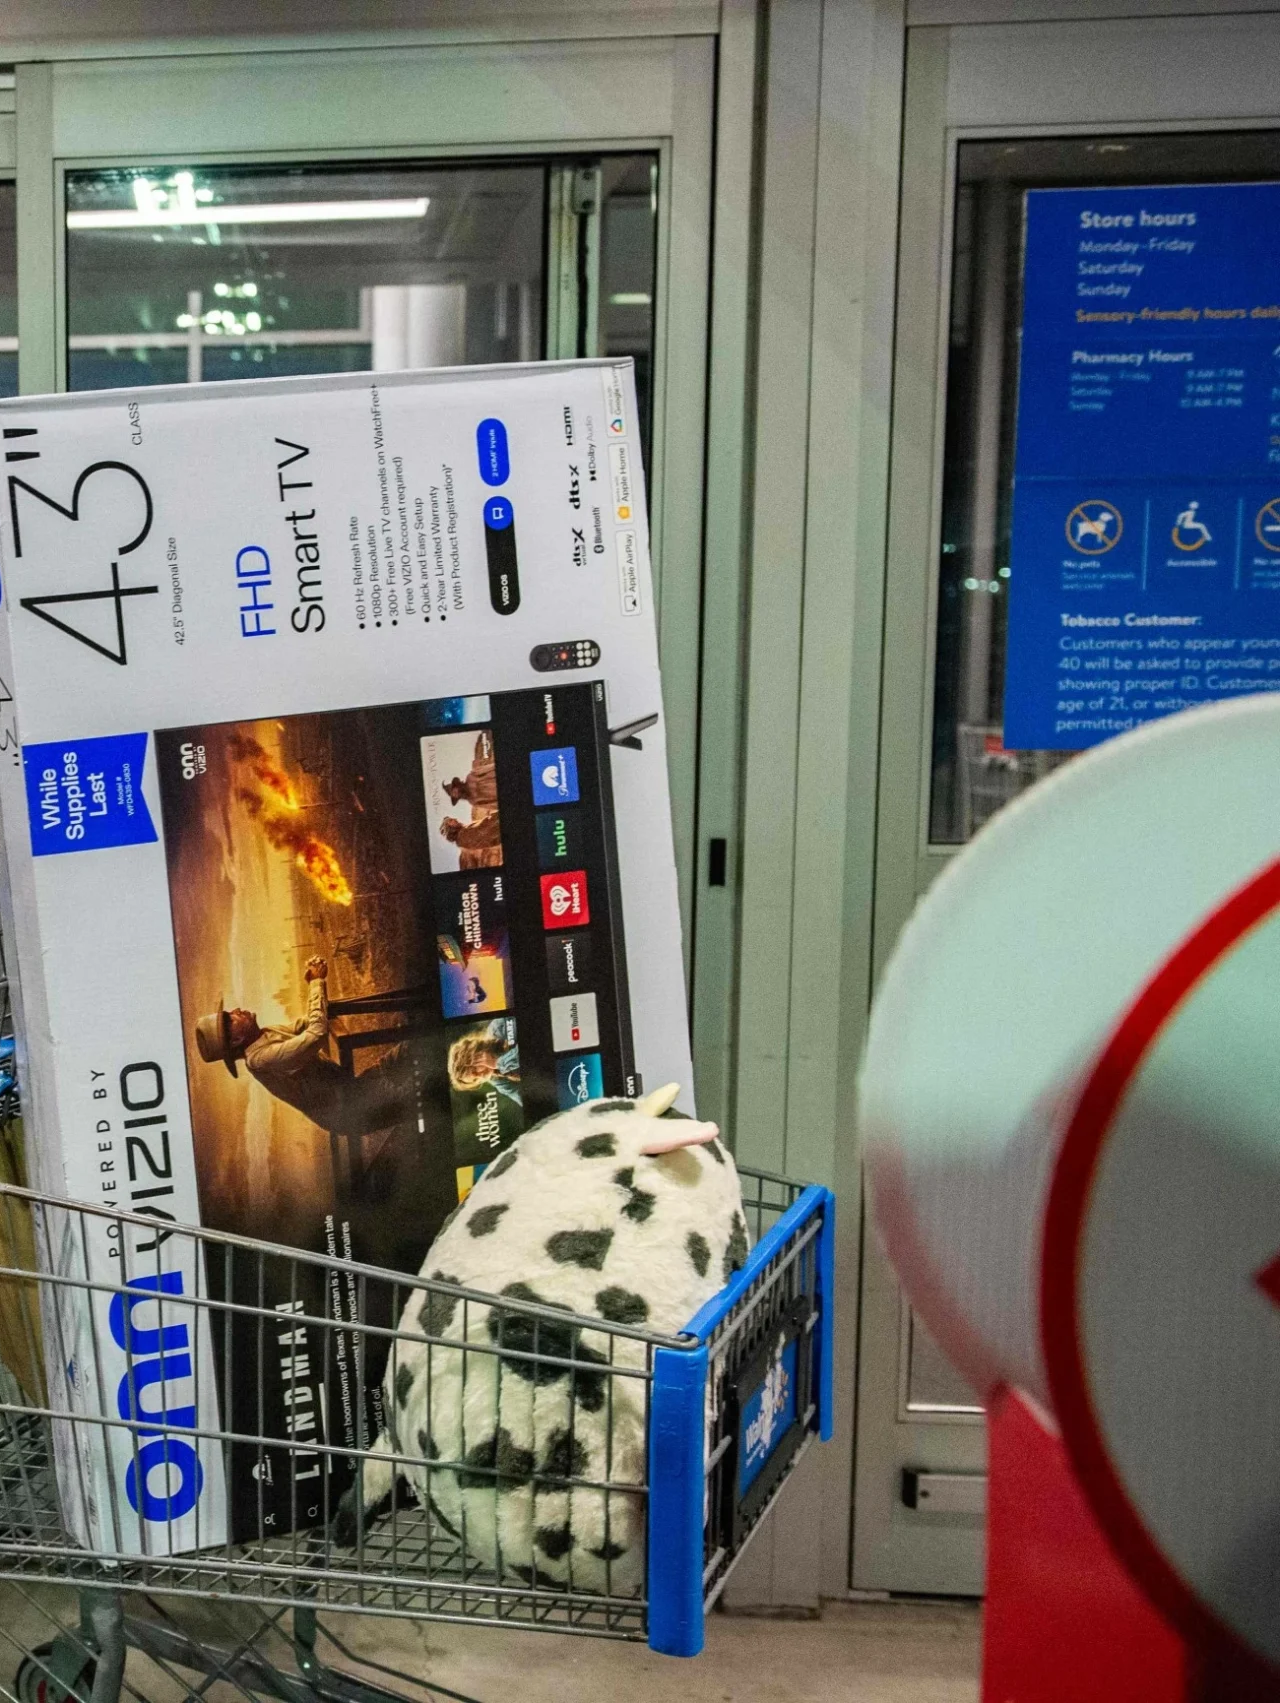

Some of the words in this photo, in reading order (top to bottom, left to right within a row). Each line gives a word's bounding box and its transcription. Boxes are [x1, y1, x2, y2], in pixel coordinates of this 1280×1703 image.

[1080, 210, 1135, 229] Store
[1139, 210, 1196, 227] hours
[1078, 260, 1144, 276] Saturday
[1076, 282, 1131, 298] Sunday
[1071, 350, 1144, 367] Pharmacy
[1148, 349, 1194, 363] Hours
[128, 402, 143, 446] CLASS
[370, 383, 384, 449] WatchFree+
[563, 406, 574, 446] HDMI
[585, 415, 595, 442] Audio
[274, 437, 313, 502] TV
[377, 451, 386, 465] on
[587, 443, 597, 469] Dolby
[617, 447, 626, 475] Home
[376, 467, 390, 516] channels
[392, 456, 408, 504] required)
[619, 476, 629, 502] Apple
[413, 497, 425, 530] Setup
[428, 485, 442, 534] Warranty
[348, 516, 360, 541] Rate
[381, 517, 392, 535] TV
[397, 507, 410, 552] Account
[591, 507, 602, 544] Bluetooth
[3, 428, 158, 666] 43"
[166, 537, 178, 560] Size
[366, 525, 380, 582] Resolution
[383, 537, 394, 558] Live
[416, 532, 428, 558] Easy
[432, 537, 445, 577] Limited
[449, 536, 461, 579] Product
[624, 534, 635, 565] AirPlay
[285, 509, 326, 634] Smart
[351, 544, 363, 585] Refresh
[385, 561, 396, 585] Free
[401, 554, 412, 585] VIZIO
[418, 560, 428, 580] and
[628, 567, 637, 592] Apple
[168, 564, 184, 613] Diagonal
[235, 545, 277, 638] FHD
[354, 588, 365, 602] Hz
[372, 584, 383, 618] 1080p
[388, 588, 399, 617] 300+
[404, 588, 416, 615] (Free
[420, 582, 432, 614] Quick
[435, 579, 448, 612] 2-Year
[452, 581, 464, 611] (With
[356, 605, 366, 620] 60
[1060, 613, 1120, 627] Tobacco
[173, 616, 185, 646] 42.5"
[1059, 635, 1143, 651] Customers
[1148, 636, 1180, 649] who
[1184, 638, 1236, 653] appear
[1058, 657, 1081, 670] 40
[1084, 656, 1110, 670] will
[1113, 657, 1133, 670] be
[1137, 656, 1181, 671] asked
[1184, 658, 1201, 670] to
[1205, 656, 1263, 673] provide
[1057, 676, 1121, 693] showing
[1124, 679, 1176, 693] proper
[1057, 699, 1084, 713] age
[1088, 697, 1104, 710] of
[1132, 700, 1149, 710] or
[1055, 717, 1134, 734] permitted
[180, 743, 195, 780] onn
[197, 745, 207, 774] VIZIO
[39, 769, 61, 829] While
[61, 752, 87, 840] Supplies
[87, 772, 108, 817] Last
[116, 782, 125, 805] Model
[552, 820, 567, 857] hulu
[492, 876, 504, 901] hulu
[570, 883, 580, 914] iHeart
[461, 892, 473, 943] INTERIOR
[468, 883, 482, 949] CHINATOWN
[563, 941, 579, 983] peacock
[569, 1002, 579, 1028] YouTube
[505, 1020, 515, 1046] STARZ
[90, 1069, 108, 1100] BY
[626, 1076, 635, 1096] onn
[475, 1102, 491, 1142] three
[483, 1090, 501, 1148] women
[119, 1061, 177, 1253] VIZIO
[324, 1215, 334, 1233] tale
[337, 1361, 347, 1371] of
[108, 1271, 204, 1522] onn
[339, 1371, 353, 1426] boomtowns
[344, 1427, 354, 1442] the
